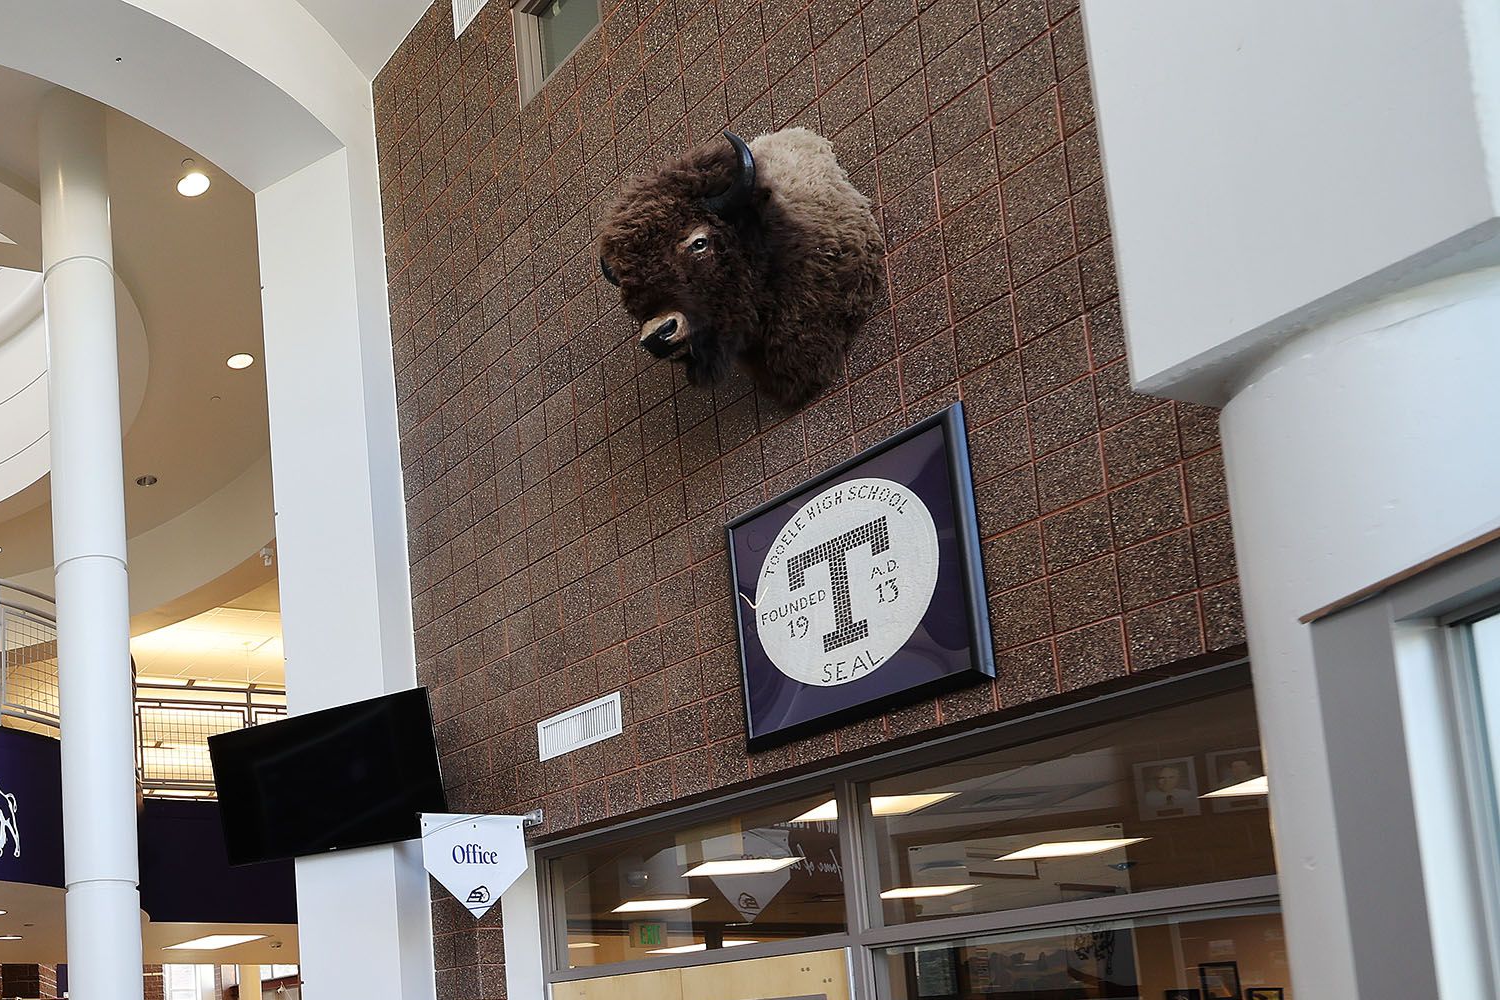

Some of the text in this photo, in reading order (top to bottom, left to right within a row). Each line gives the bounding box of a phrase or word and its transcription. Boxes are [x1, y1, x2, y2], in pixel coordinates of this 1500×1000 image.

[763, 484, 908, 579] TOOELE HIGH SCHOOL
[786, 515, 890, 652] T
[870, 559, 899, 579] A.D.
[874, 577, 900, 604] 13
[760, 589, 827, 626] FOUNDED
[786, 615, 810, 640] 19
[820, 649, 887, 684] SEAL
[452, 843, 499, 865] Office
